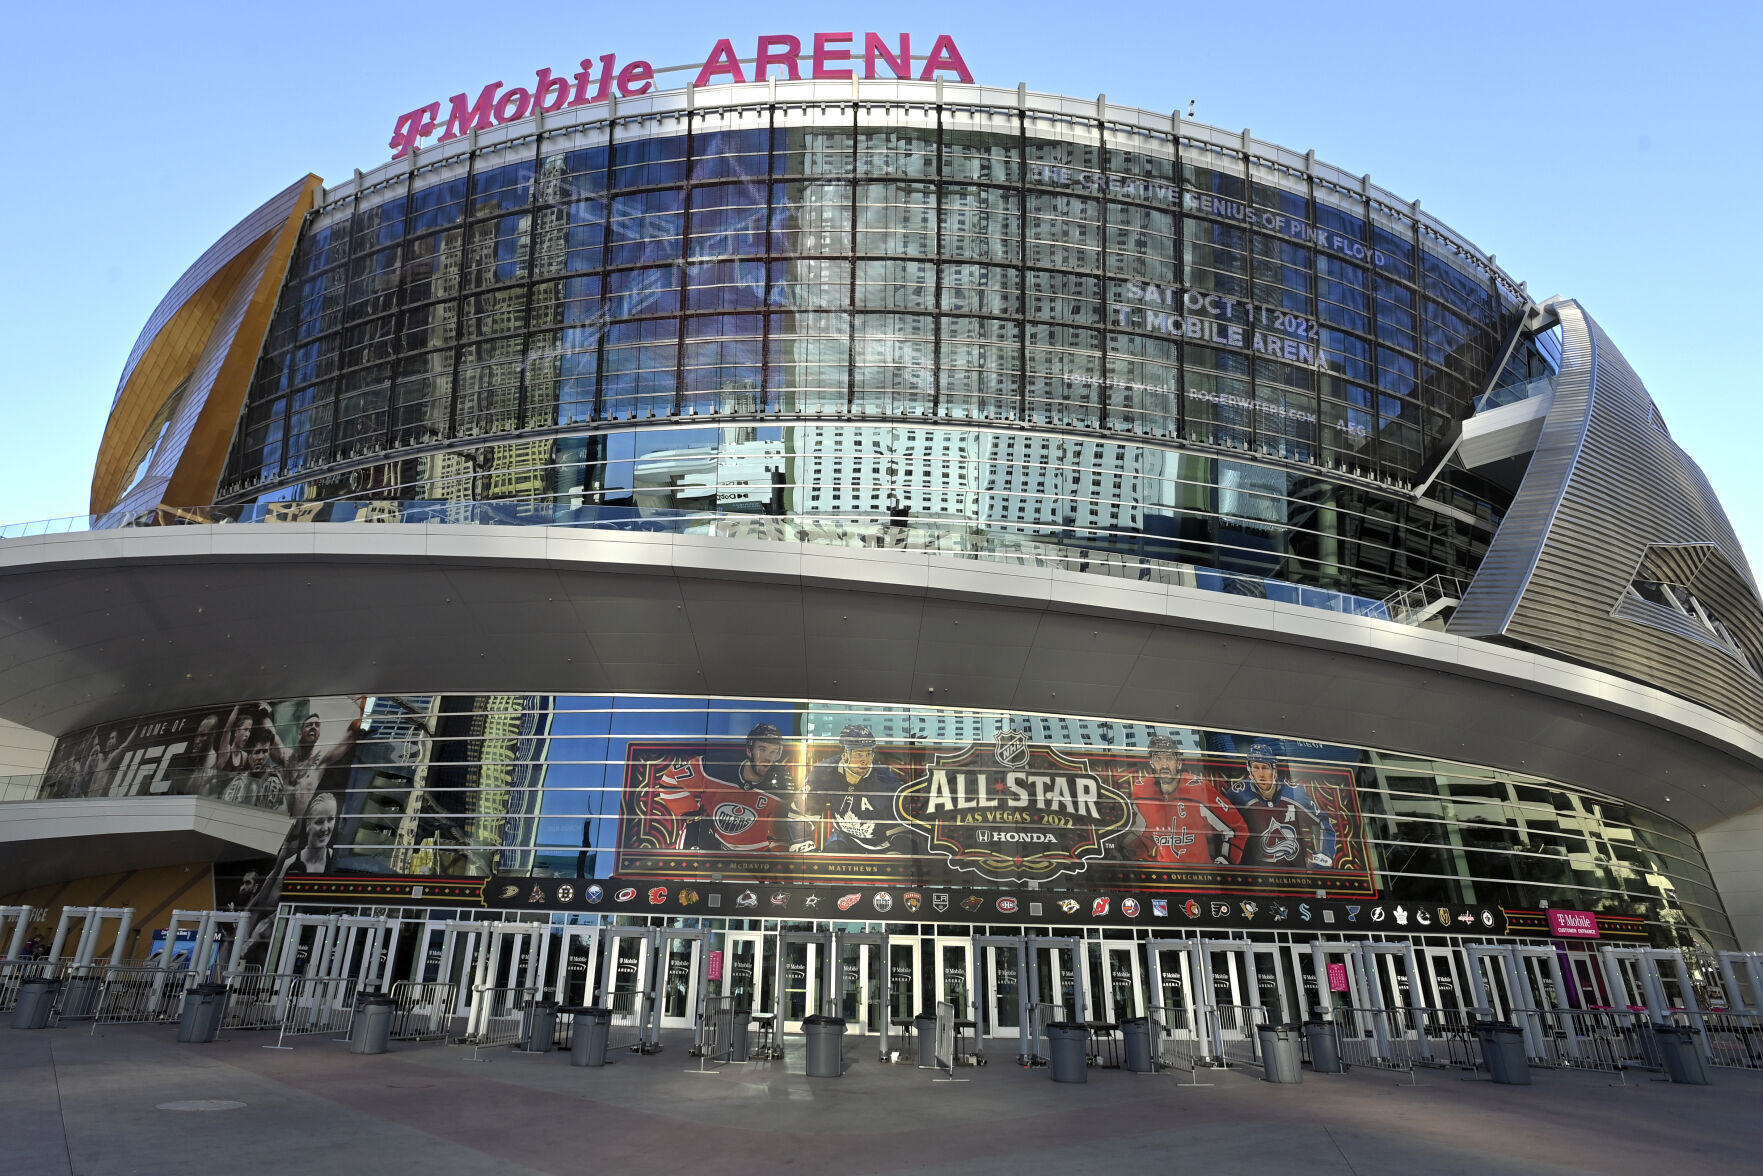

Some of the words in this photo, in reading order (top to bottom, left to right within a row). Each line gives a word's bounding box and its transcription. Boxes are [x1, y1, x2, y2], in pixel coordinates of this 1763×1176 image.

[693, 31, 975, 87] ARENA
[1033, 165, 1072, 185] THE
[1080, 172, 1180, 203] CREATIVE
[1187, 193, 1257, 223] GENIUS
[1263, 212, 1285, 230] OF
[1290, 220, 1328, 247] PINK
[1333, 235, 1384, 266] FLOYD
[1127, 280, 1179, 304] SAT
[1185, 290, 1236, 318] OCT
[1273, 311, 1319, 340] 2022
[1253, 331, 1329, 369] ARENA
[140, 722, 168, 738] HOME
[171, 718, 187, 732] OF
[1002, 740, 1023, 760] NHL
[108, 741, 189, 797] UFC
[861, 797, 874, 811] A
[926, 769, 998, 814] ALL
[1006, 772, 1102, 820] STAR
[956, 811, 983, 825] LAS
[986, 810, 1031, 823] VEGAS
[1040, 813, 1074, 829] 2022
[992, 832, 1058, 843] HONDA
[828, 864, 878, 872] MATTHEWS
